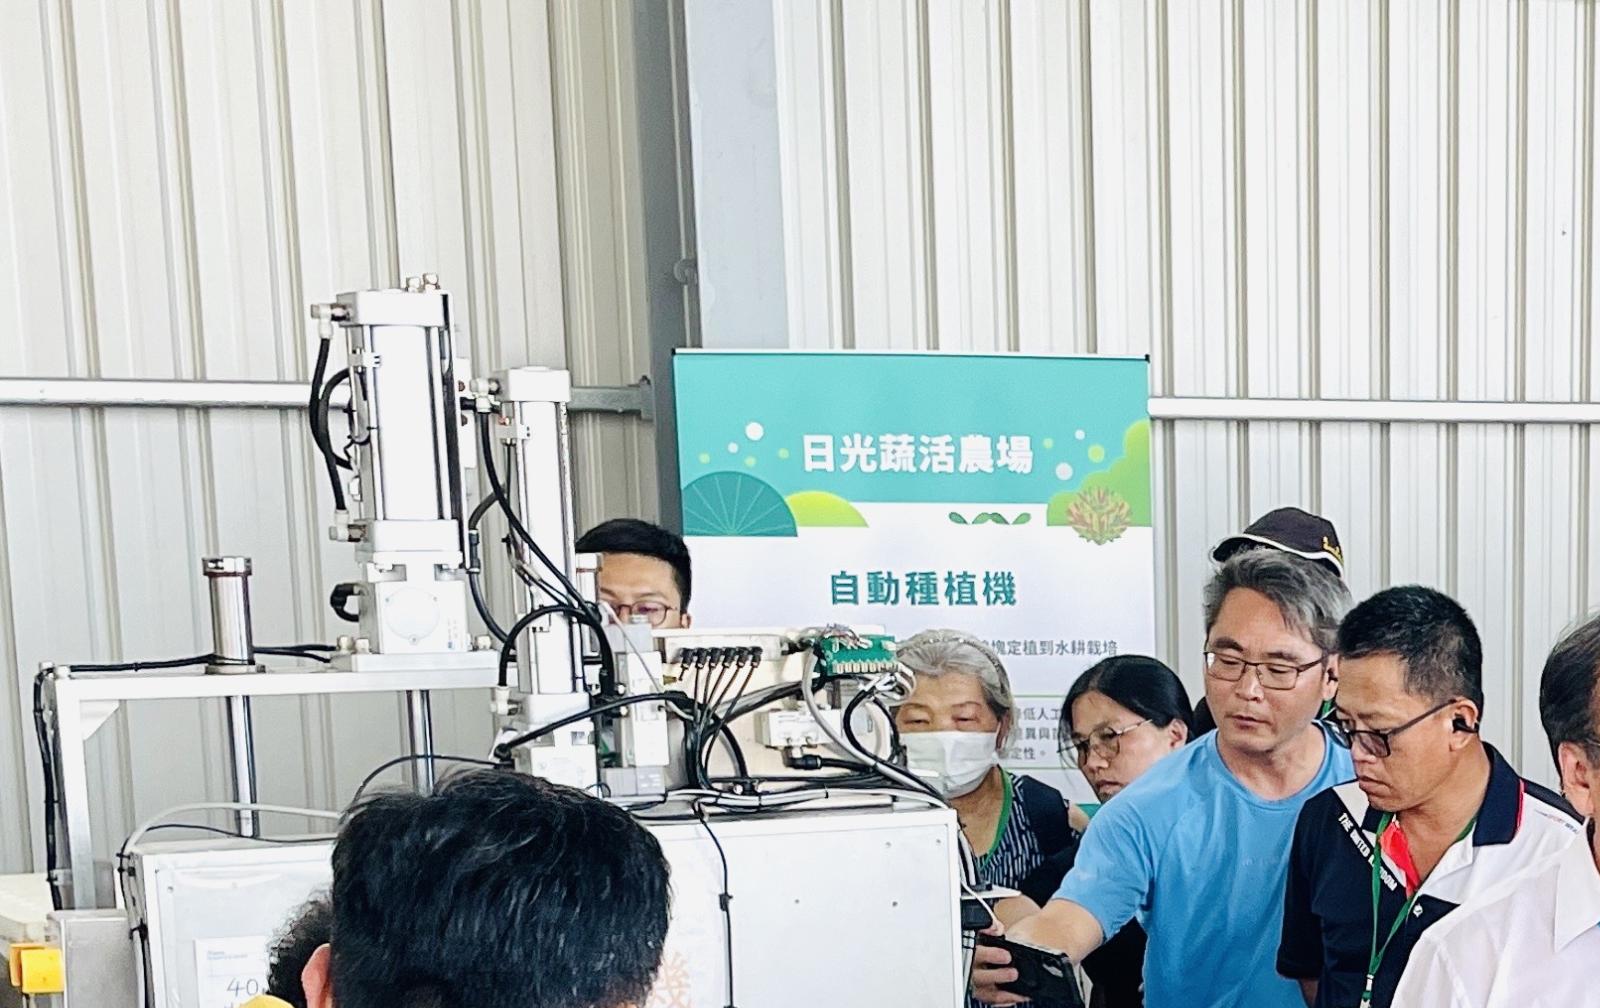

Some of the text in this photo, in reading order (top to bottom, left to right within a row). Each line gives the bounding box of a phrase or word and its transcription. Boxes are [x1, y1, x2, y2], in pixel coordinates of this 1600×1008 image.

[803, 433, 1033, 475] 日光蔬活農場
[831, 570, 1017, 606] 自動種植機
[984, 639, 1118, 656] 塊定植到水耕栽培
